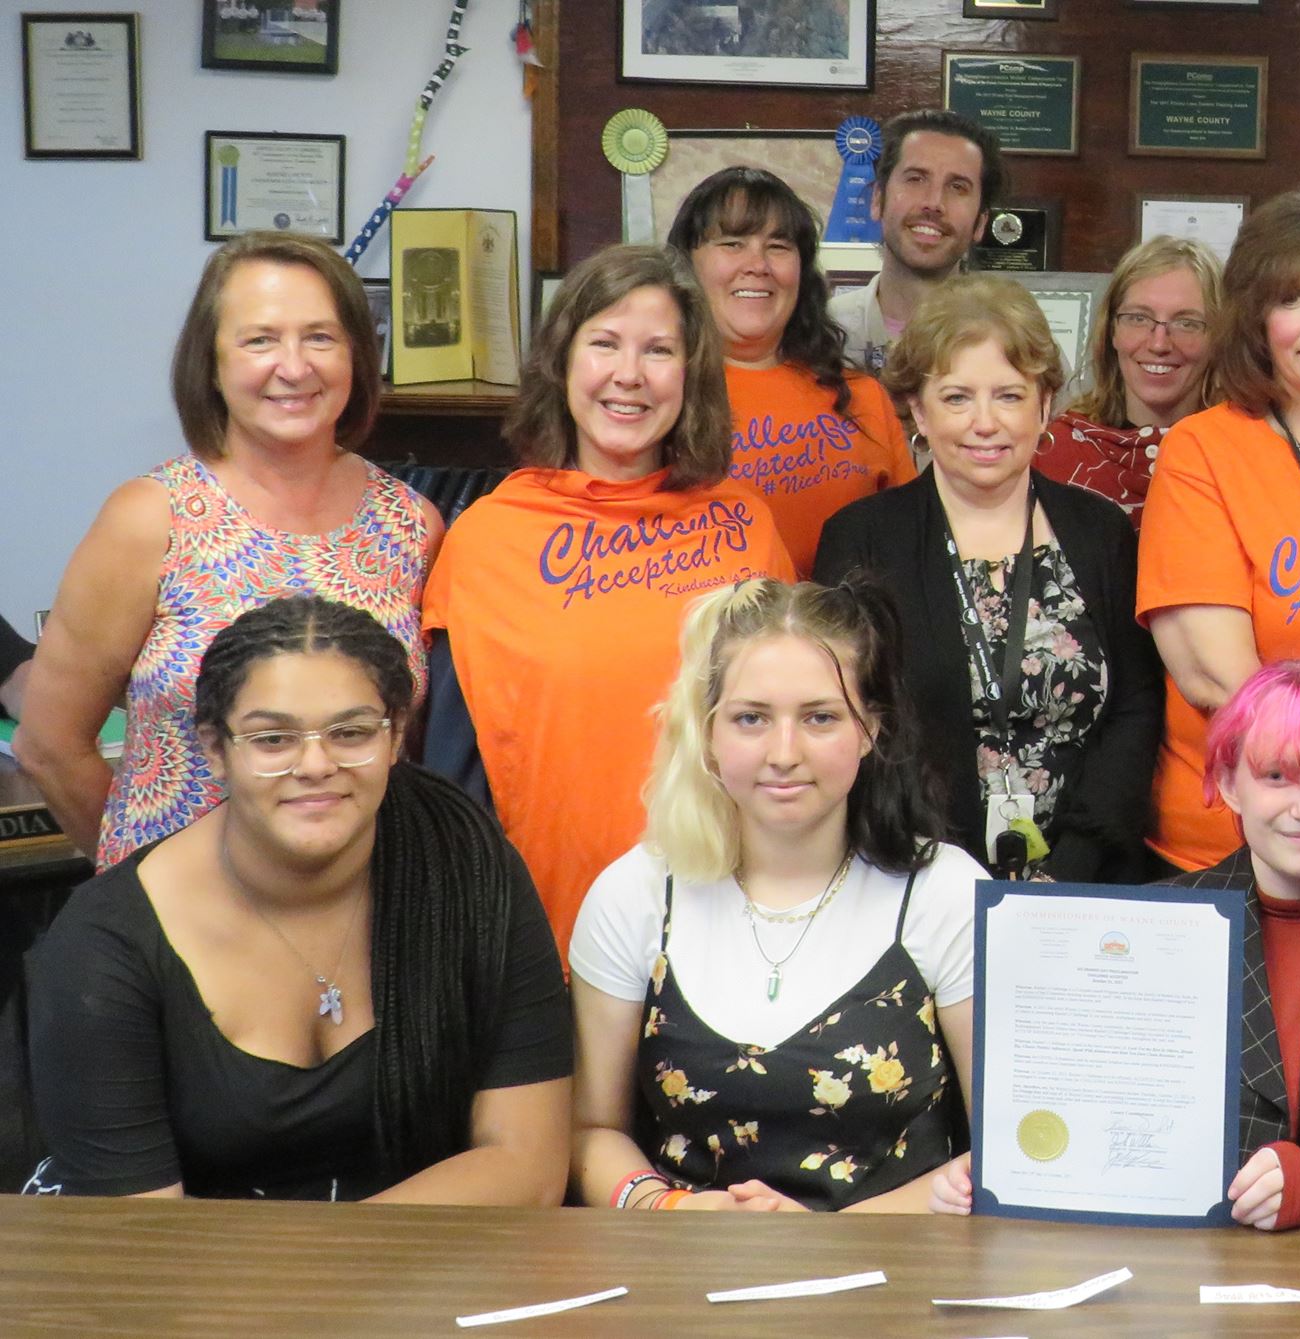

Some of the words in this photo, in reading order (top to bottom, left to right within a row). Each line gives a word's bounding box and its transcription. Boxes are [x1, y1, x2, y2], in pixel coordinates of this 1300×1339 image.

[980, 109, 1007, 117] WAYNE
[1009, 110, 1041, 118] COUNTY
[1166, 115, 1195, 123] WAYNE
[1197, 116, 1231, 125] COUNTY
[731, 413, 860, 452] allenge
[729, 439, 826, 487] cepted!
[563, 529, 721, 609] Accepted!
[659, 575, 726, 599] Kindness
